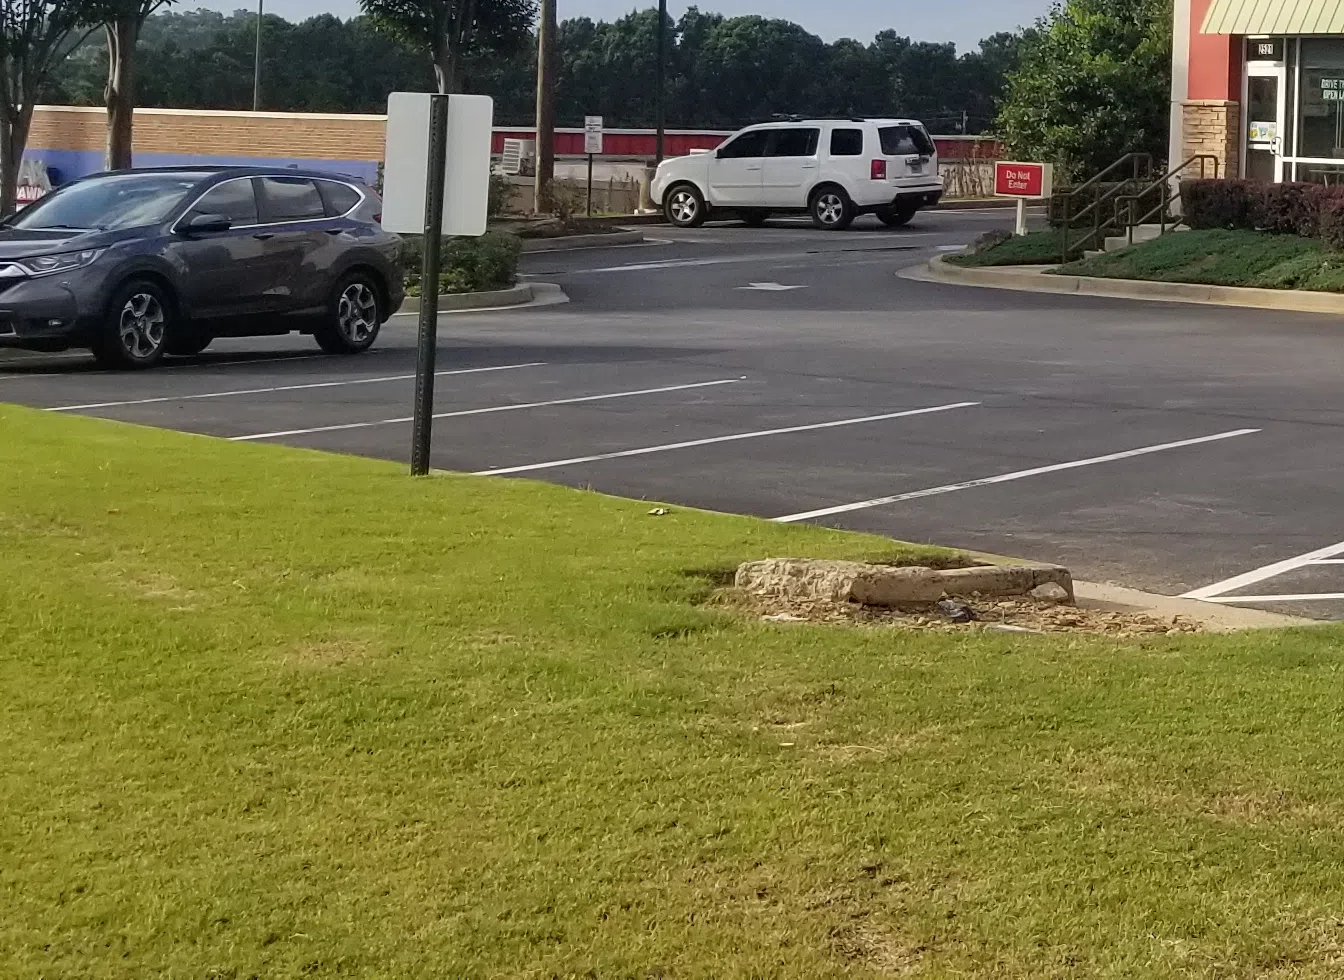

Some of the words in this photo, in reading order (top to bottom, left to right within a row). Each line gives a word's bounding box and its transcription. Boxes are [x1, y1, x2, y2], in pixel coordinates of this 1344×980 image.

[1006, 170, 1017, 179] Do
[1017, 171, 1030, 180] Not
[1008, 180, 1028, 190] Enter
